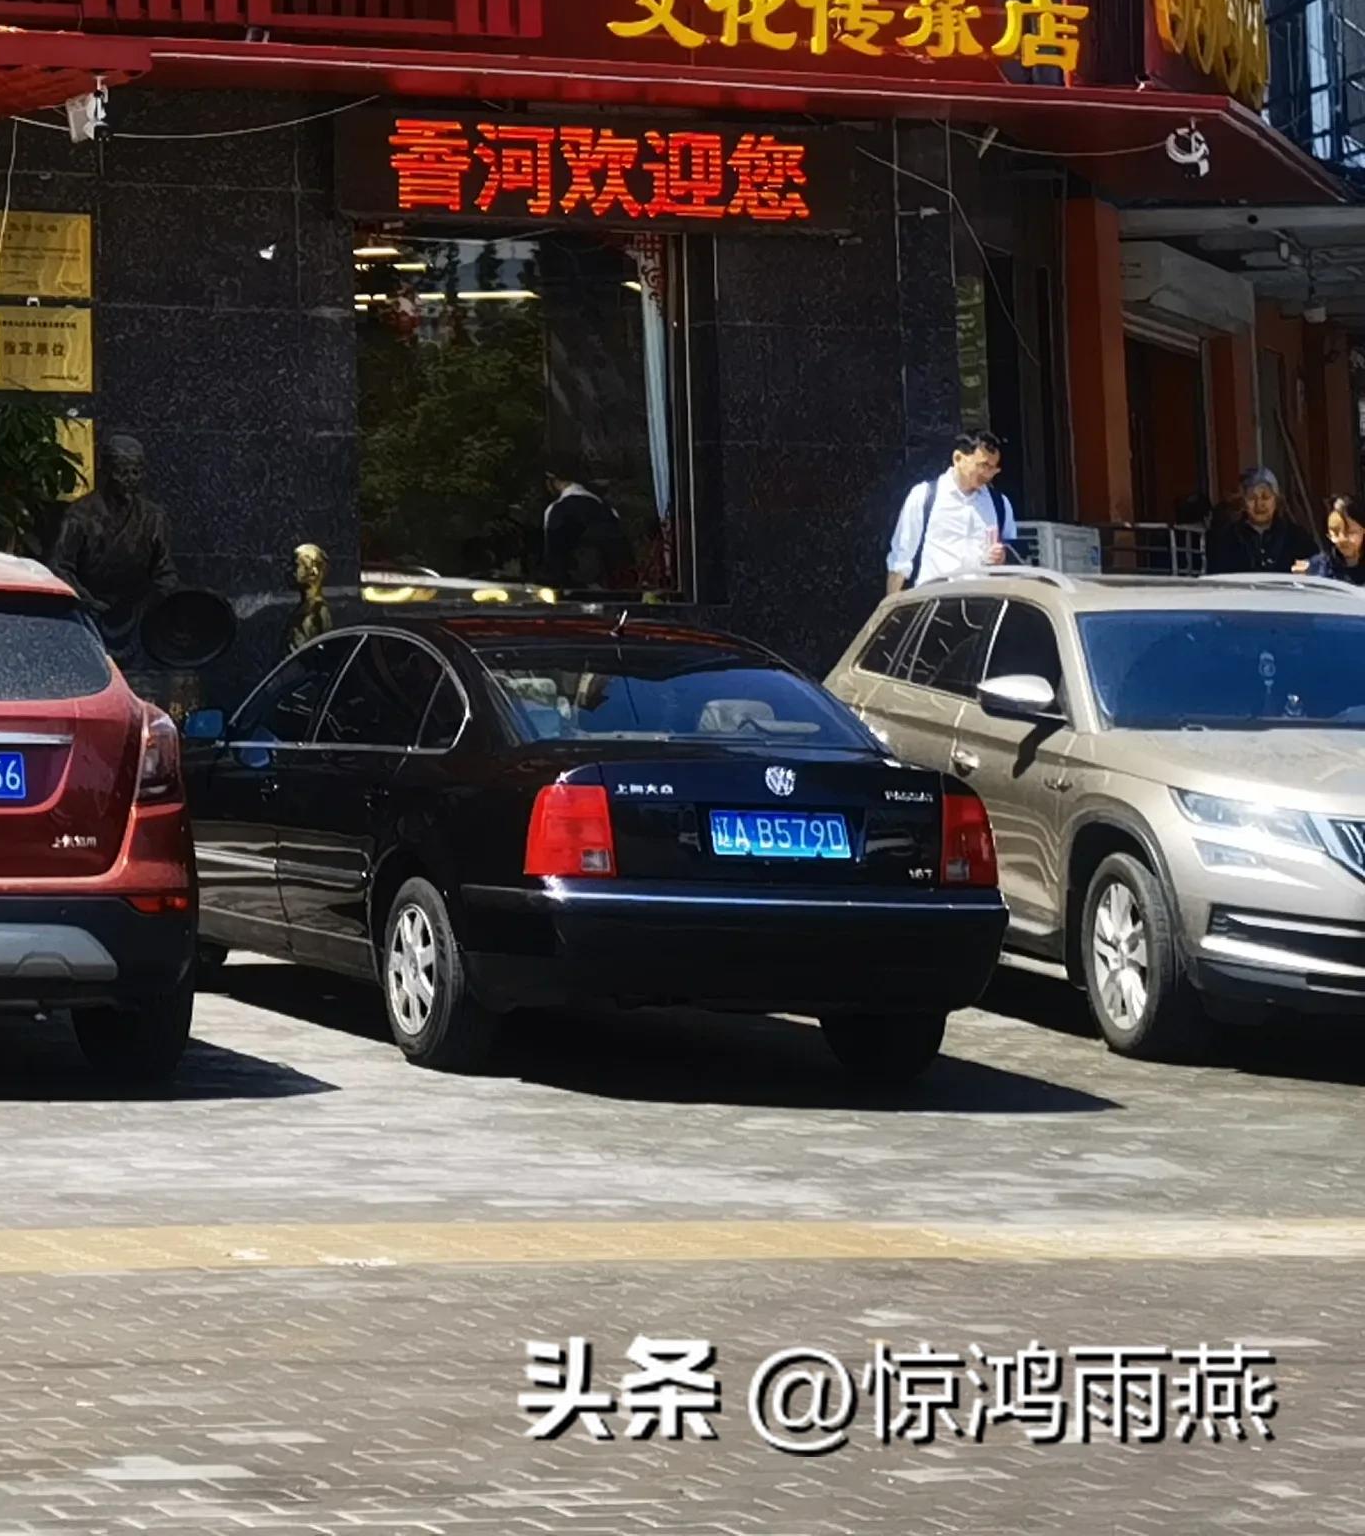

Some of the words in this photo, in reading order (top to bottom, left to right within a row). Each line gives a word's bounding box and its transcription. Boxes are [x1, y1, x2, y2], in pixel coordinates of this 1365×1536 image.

[387, 118, 811, 222] 香河欢迎您
